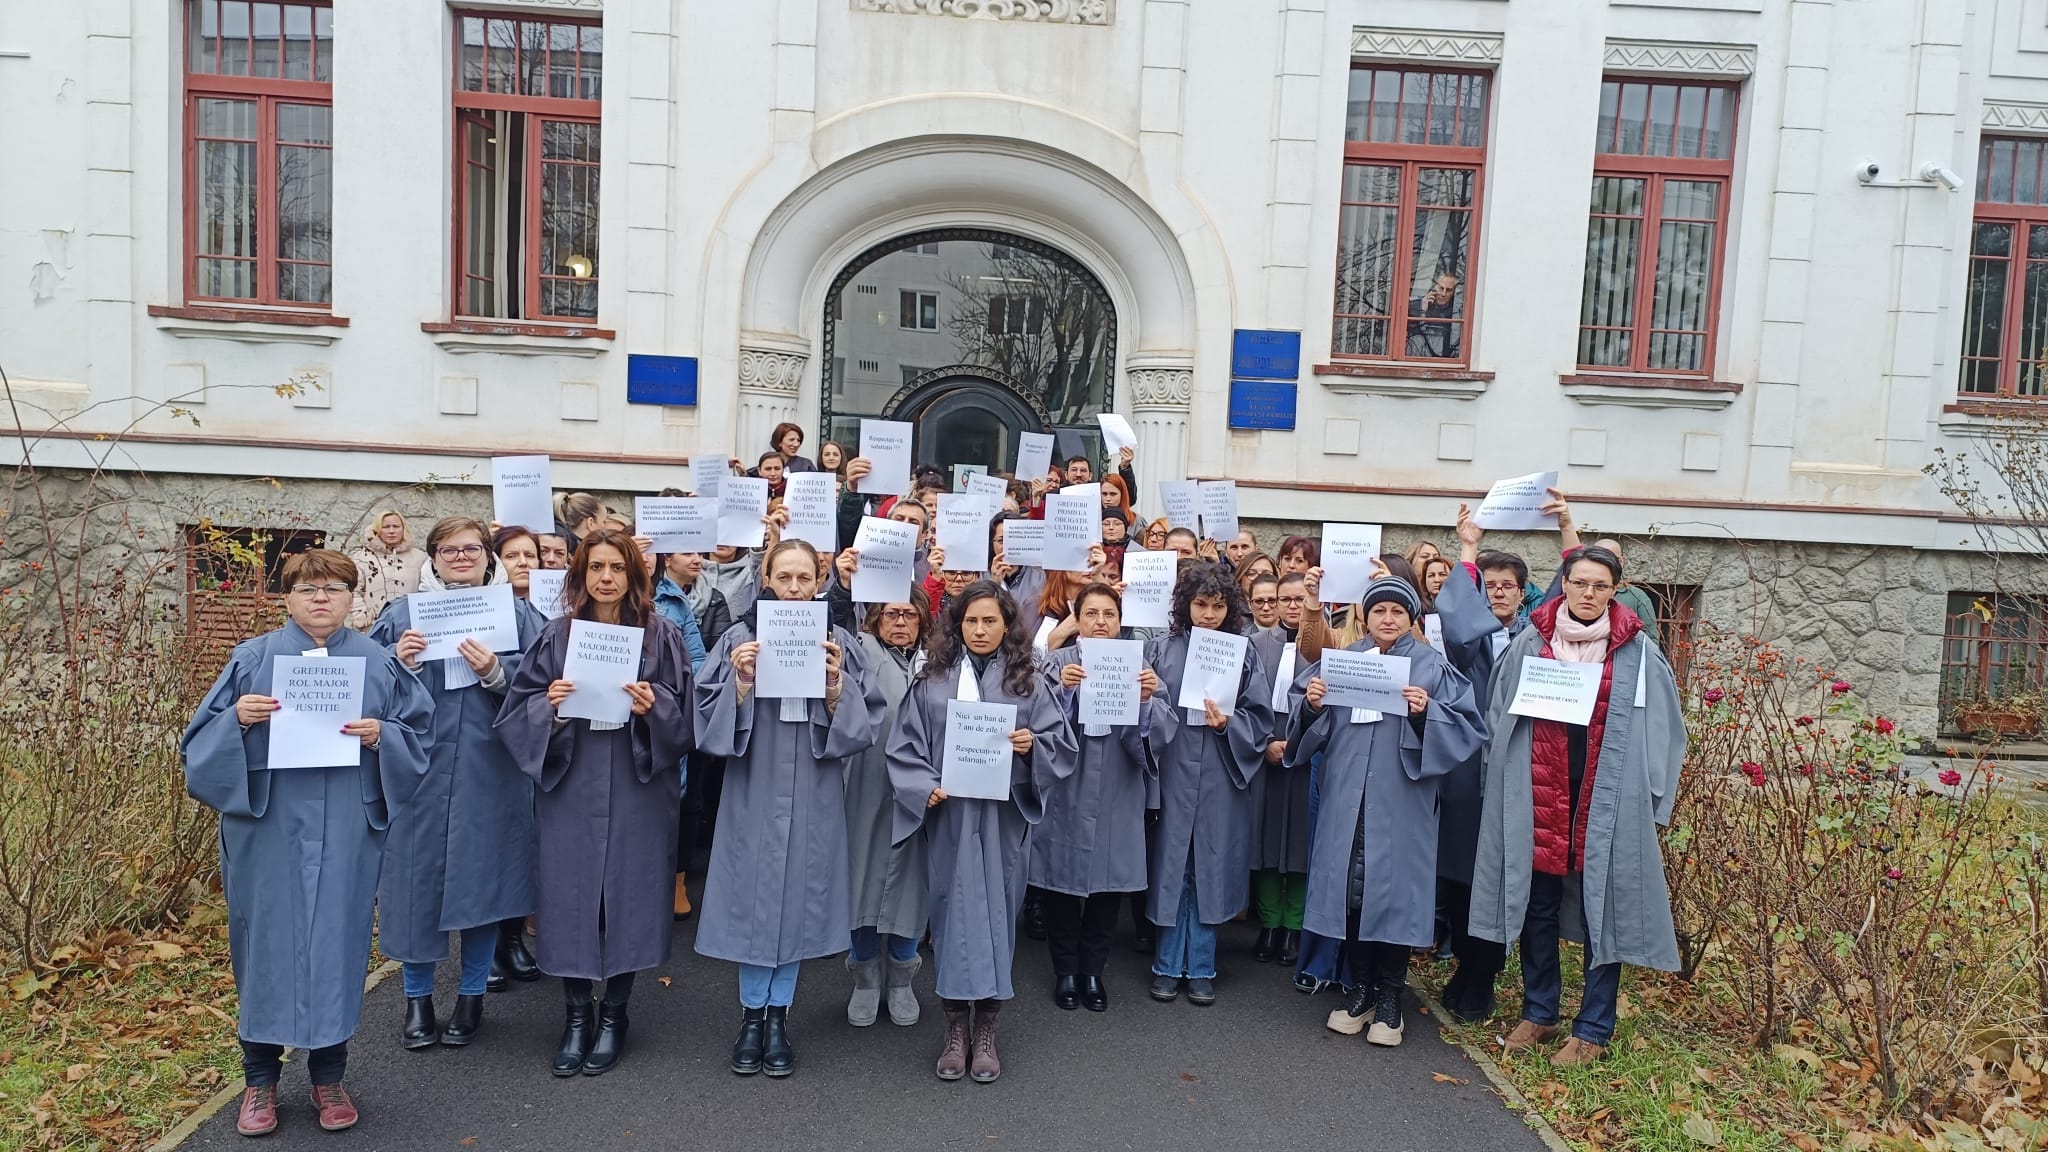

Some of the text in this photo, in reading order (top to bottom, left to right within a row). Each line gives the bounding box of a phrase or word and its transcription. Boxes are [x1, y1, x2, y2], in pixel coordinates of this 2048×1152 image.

[502, 473, 541, 481] Respectați-vă
[888, 528, 899, 537] ban
[901, 531, 909, 539] de
[889, 539, 900, 547] zile
[426, 598, 456, 606] SOLICITĂM
[442, 603, 471, 611] SOLICITĂM
[419, 612, 449, 621] INTEGRALĂ
[454, 609, 484, 617] SALARIULUI
[769, 619, 816, 627] INTEGRALĂ
[598, 633, 629, 643] CEREM
[578, 641, 631, 655] MAJORAREA
[1199, 645, 1235, 658] ROL MAJOR
[577, 652, 629, 665] SALARIULUI
[1195, 652, 1202, 660] ÎN
[1203, 656, 1225, 665] ACTUL
[293, 667, 348, 675] GREFIERII,
[289, 679, 350, 687] ROL MAJOR
[285, 691, 352, 700] ÎN ACTUL DE
[295, 704, 340, 712] JUSTIȚIE
[984, 714, 996, 722] ban
[998, 715, 1007, 723] de
